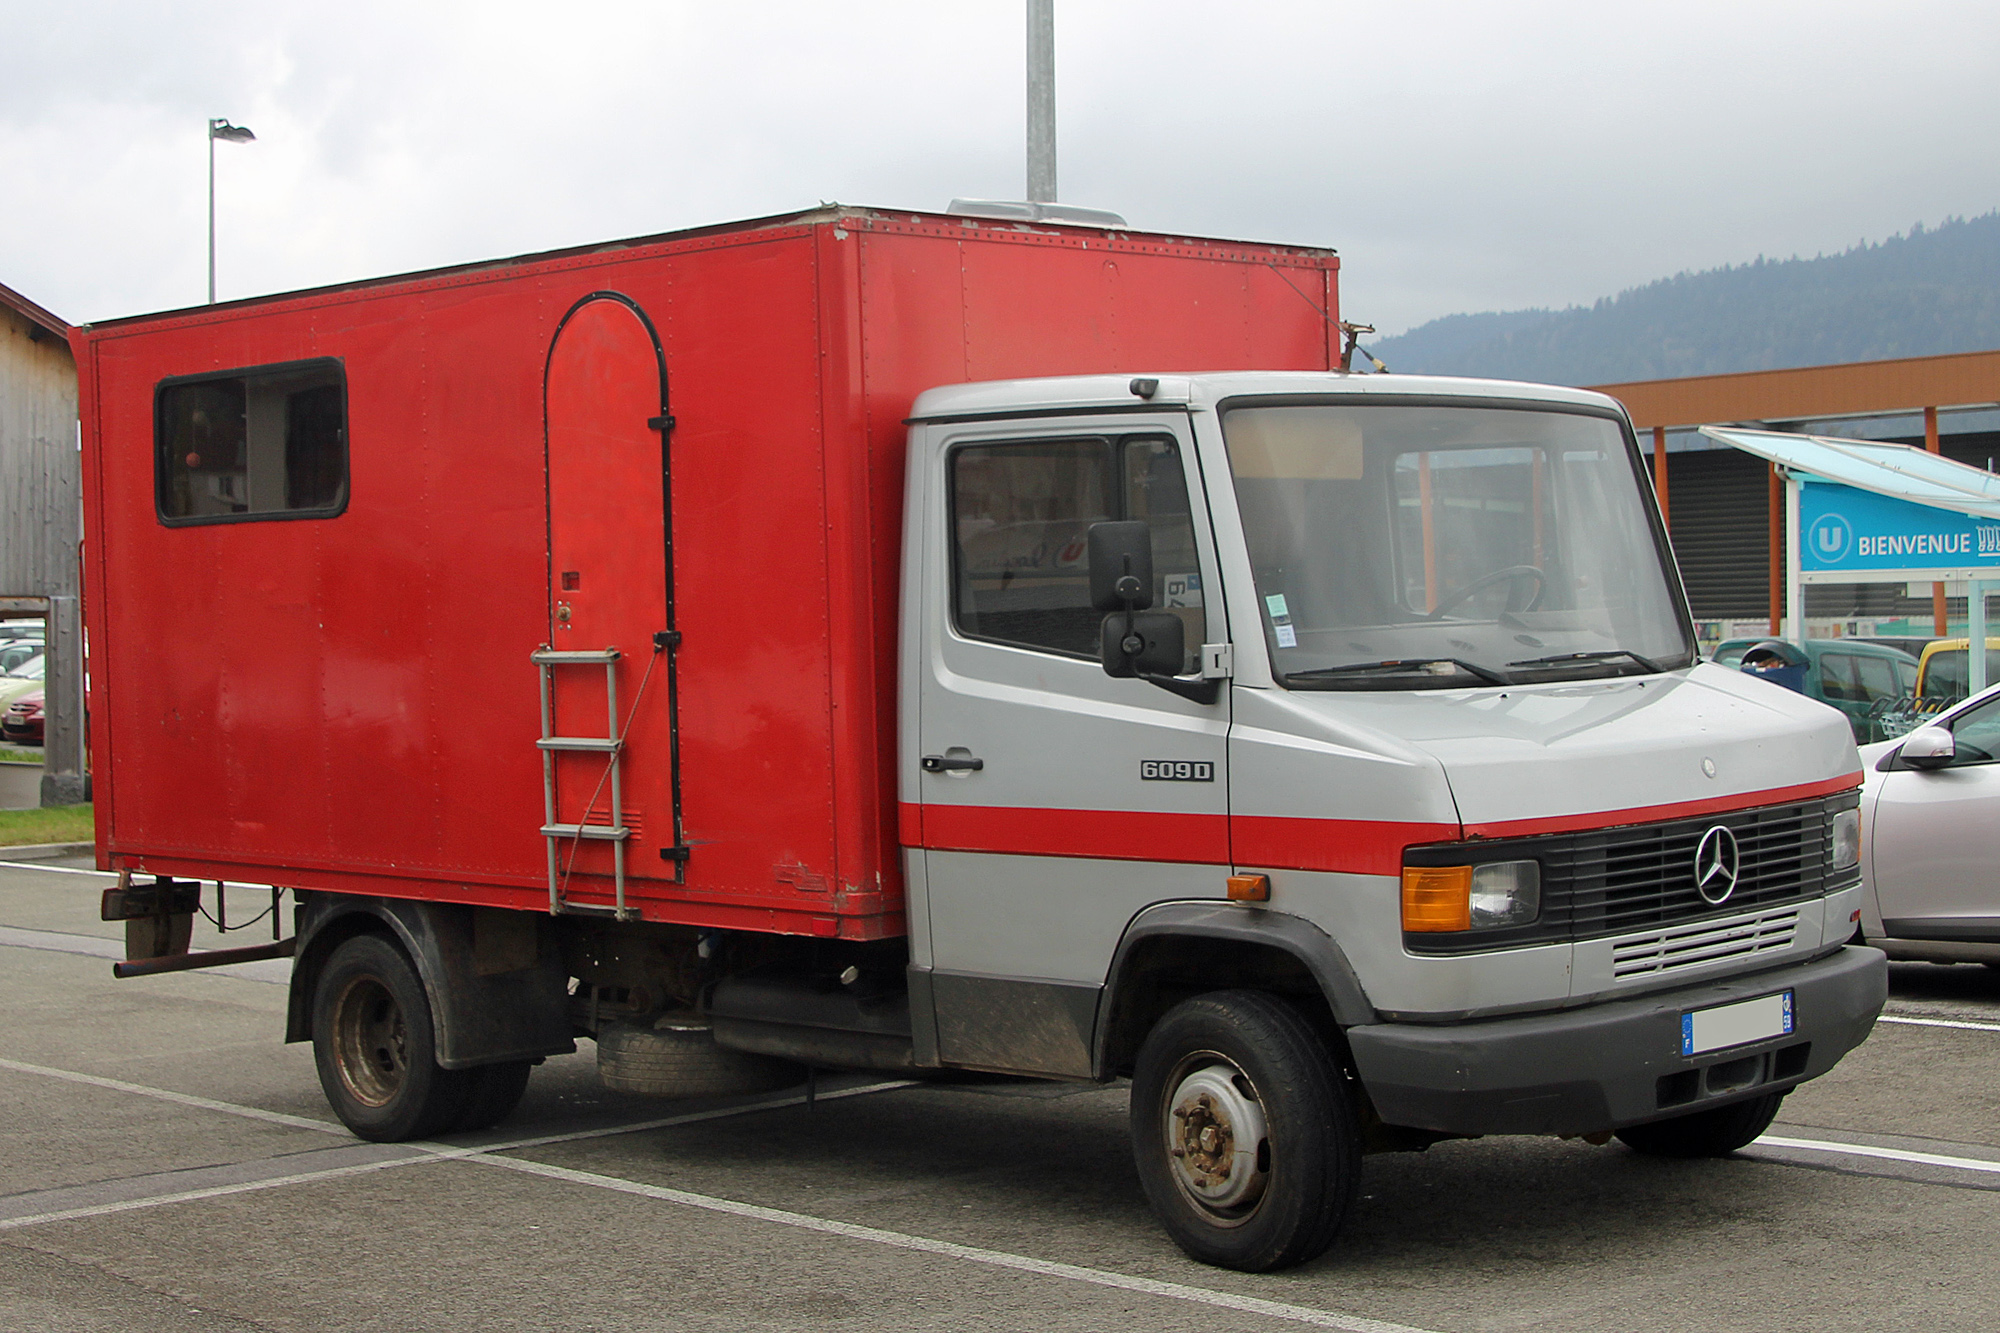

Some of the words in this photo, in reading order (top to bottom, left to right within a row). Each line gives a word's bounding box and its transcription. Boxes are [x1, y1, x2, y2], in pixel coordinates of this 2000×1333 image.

[1819, 527, 1842, 552] U
[1858, 533, 1971, 556] BIENVENUE
[1142, 762, 1211, 779] 609D
